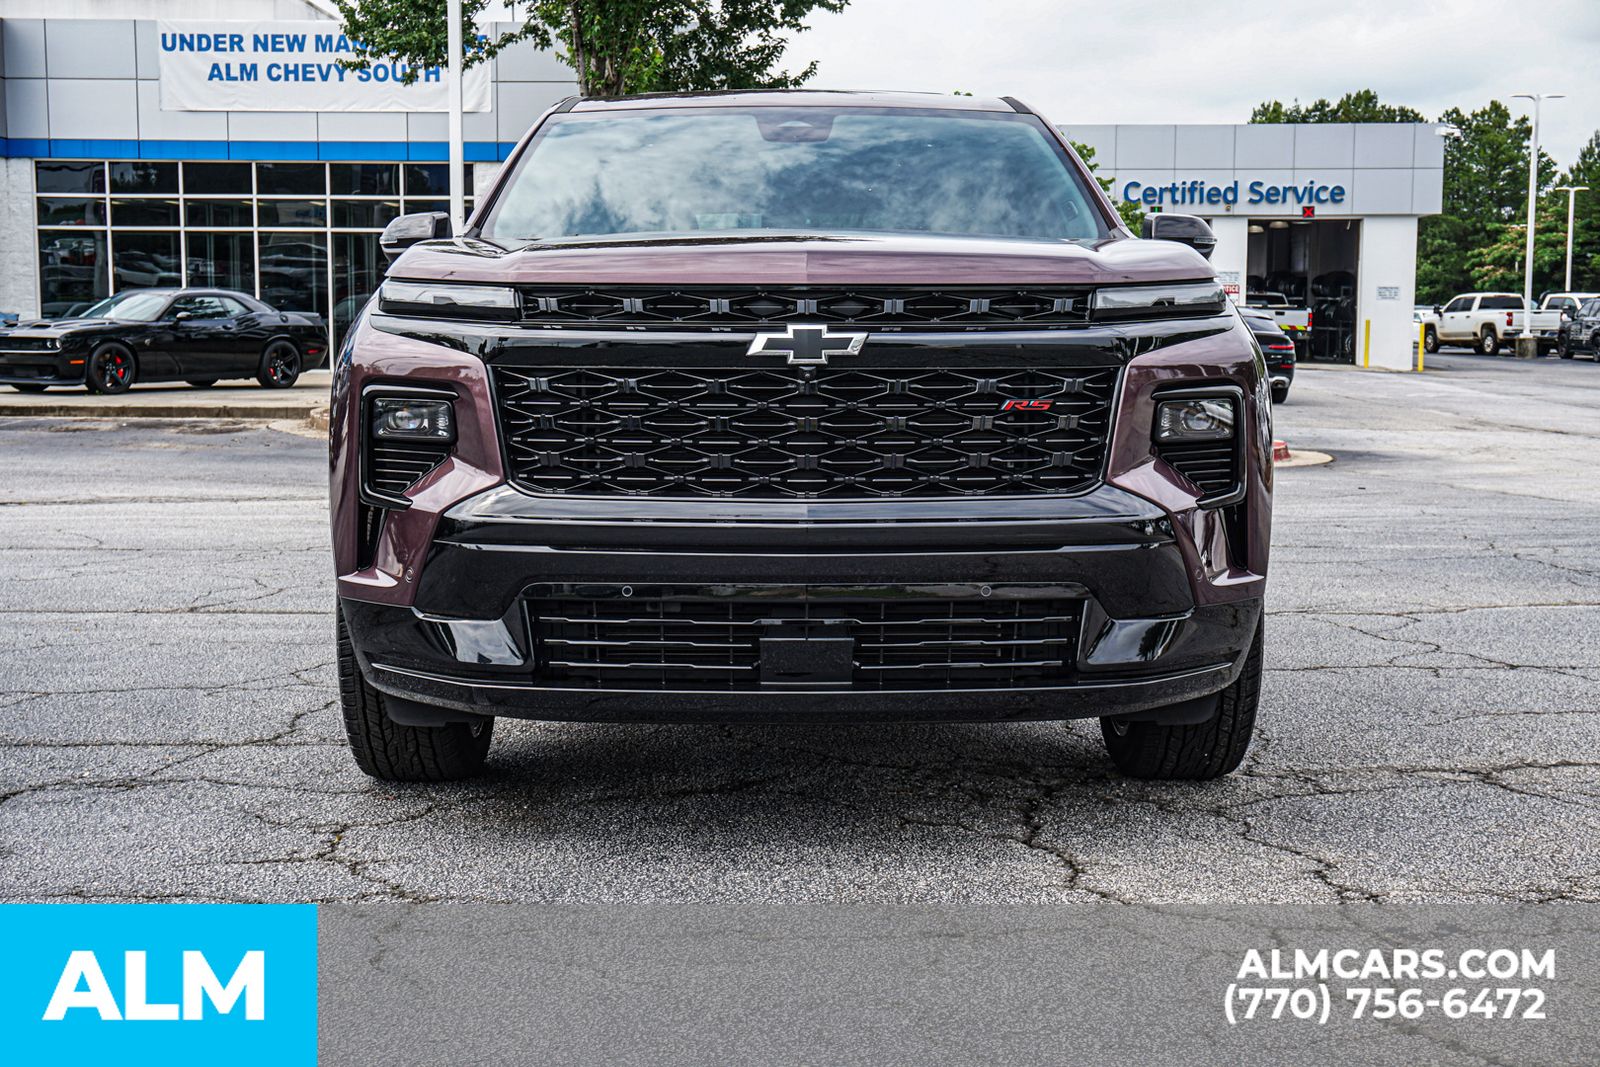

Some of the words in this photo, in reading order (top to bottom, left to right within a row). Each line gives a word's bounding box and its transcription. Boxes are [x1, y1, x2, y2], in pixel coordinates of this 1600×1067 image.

[161, 33, 245, 53] UNDER
[253, 34, 307, 53] NEW
[207, 63, 258, 82] ALM
[266, 63, 347, 82] CHEVY
[1123, 180, 1239, 205] Certified
[1248, 180, 1346, 205] Service
[1001, 399, 1054, 411] RS
